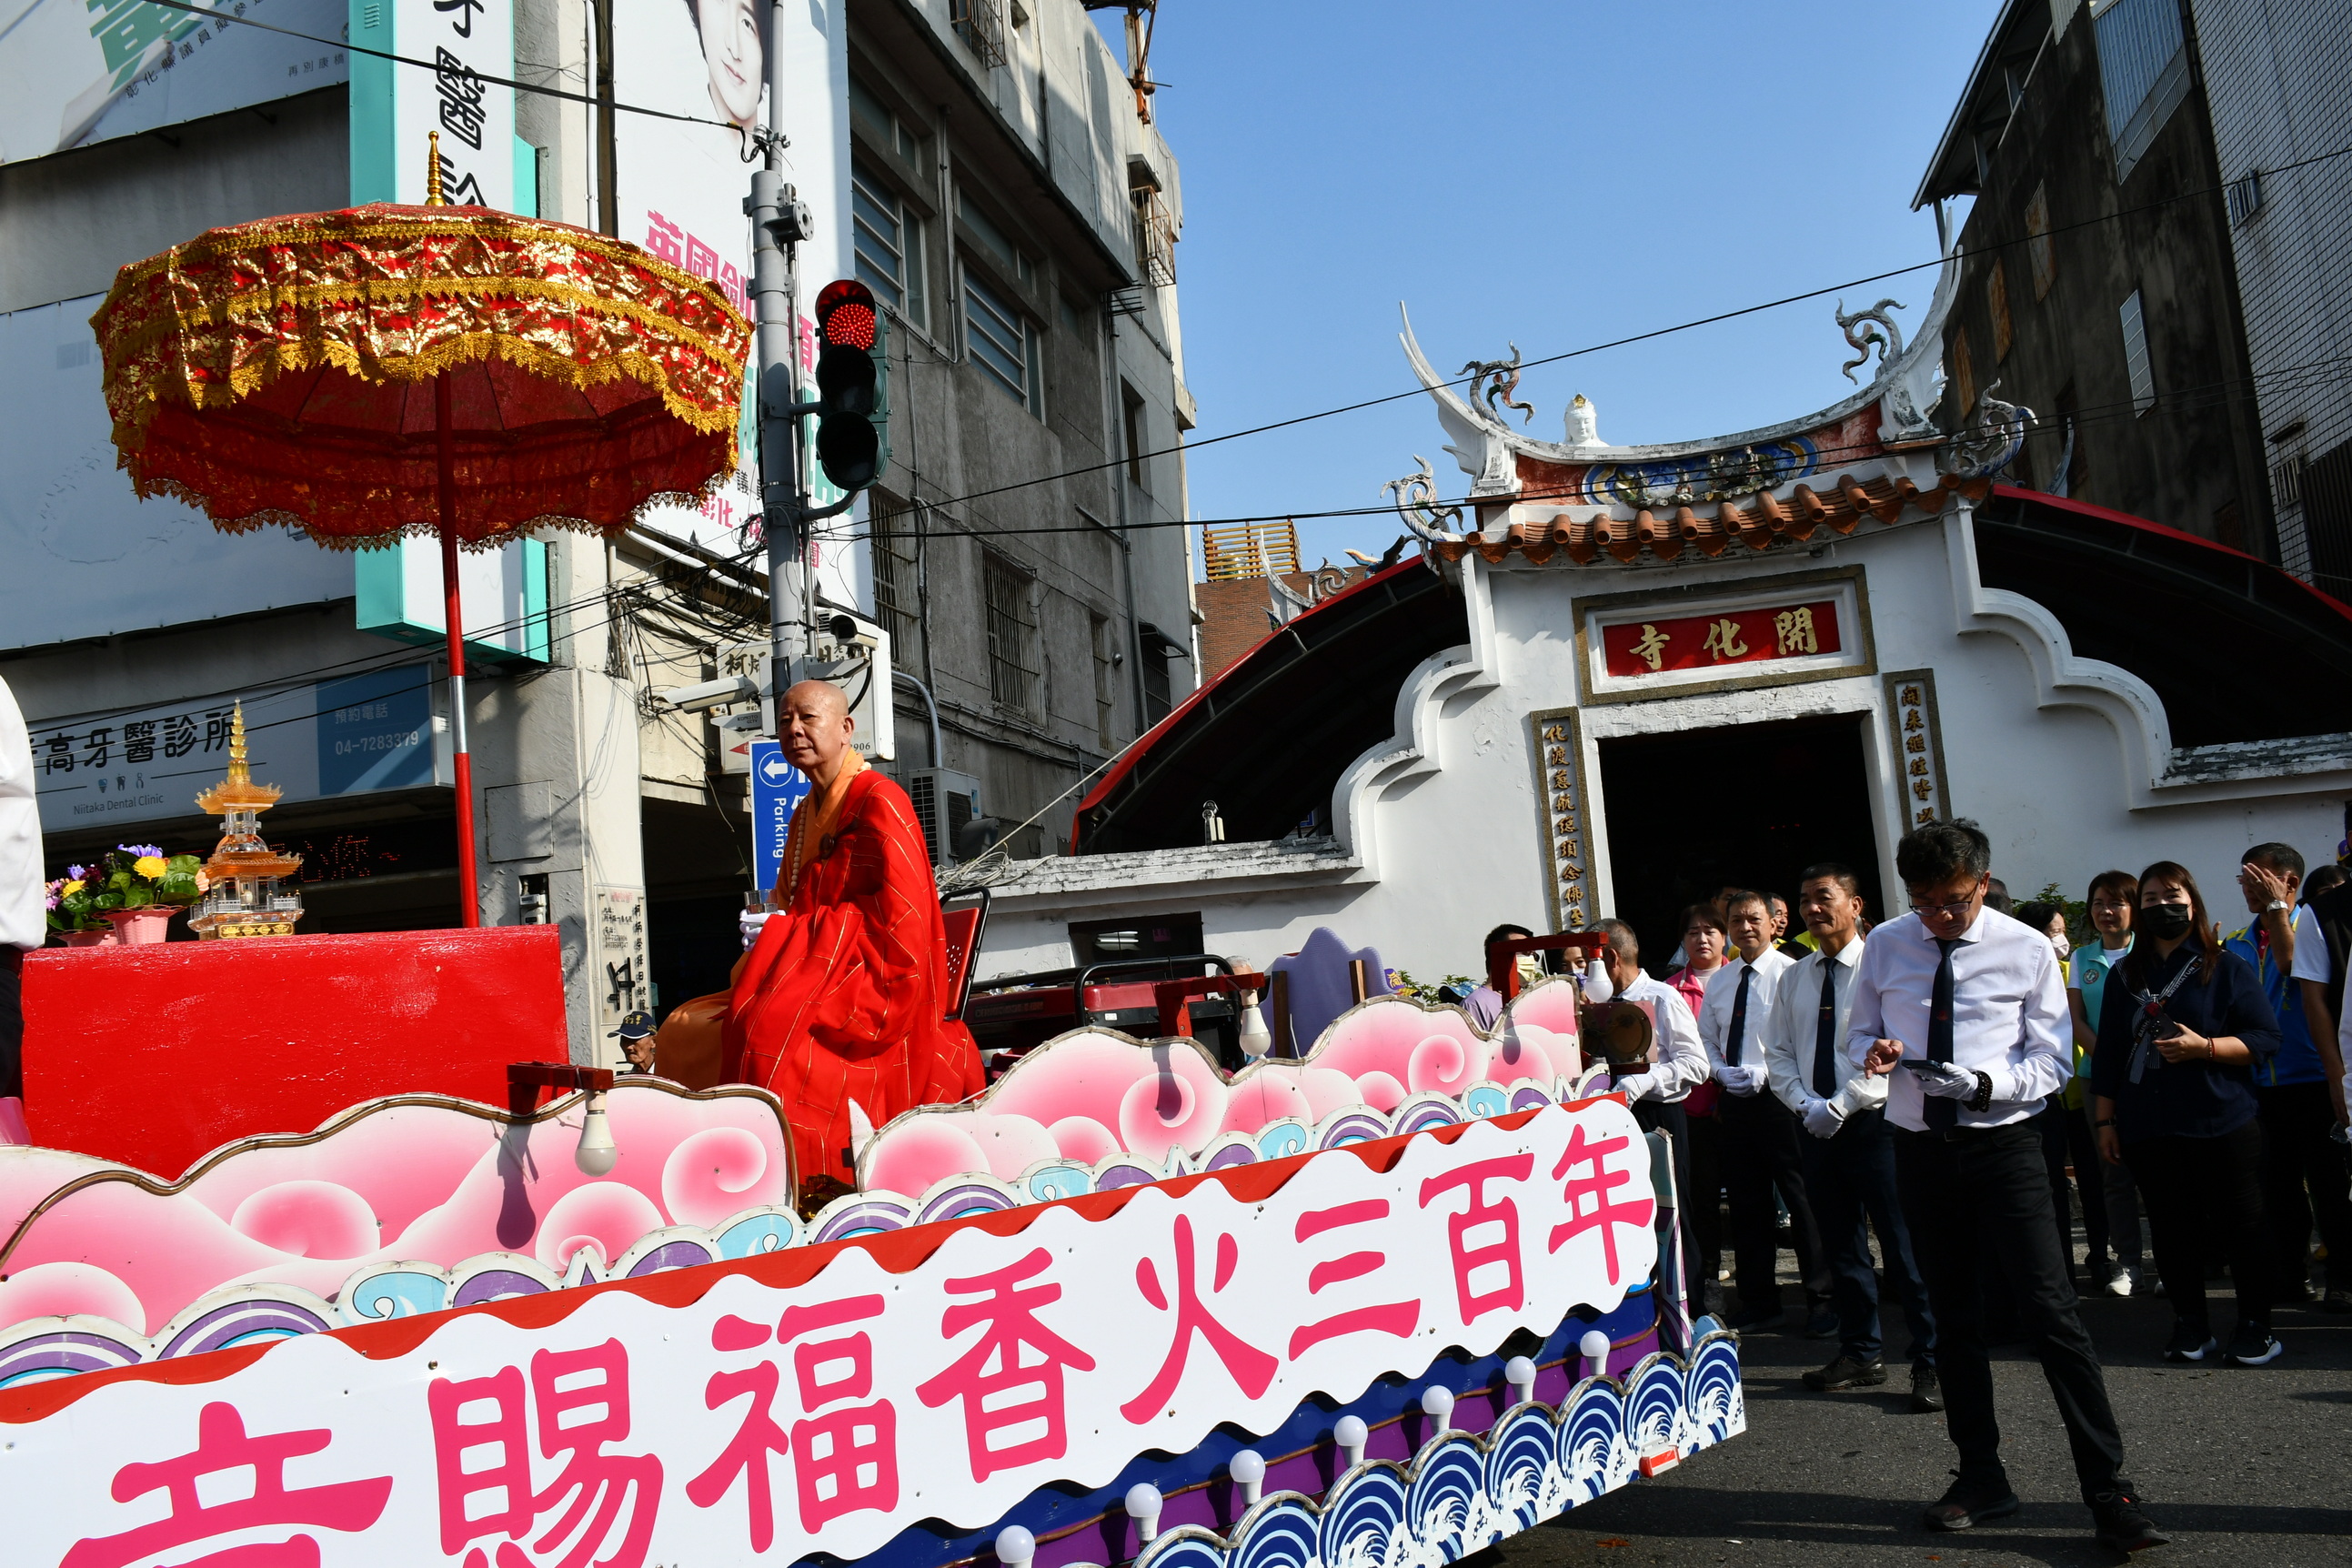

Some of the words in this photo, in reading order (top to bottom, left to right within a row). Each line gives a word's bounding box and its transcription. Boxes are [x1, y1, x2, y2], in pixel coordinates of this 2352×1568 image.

[124, 0, 265, 100] 彰化縣議員擬參
[288, 53, 345, 78] 再別康橋
[1630, 607, 1819, 671] 開化寺
[335, 703, 388, 725] 預約電話
[30, 710, 236, 775] 高牙醫診所
[336, 730, 419, 755] 04-7283379
[74, 801, 106, 815] Niitaka
[107, 797, 136, 809] Dental
[138, 793, 164, 806] Clinic
[772, 797, 789, 858] Parking
